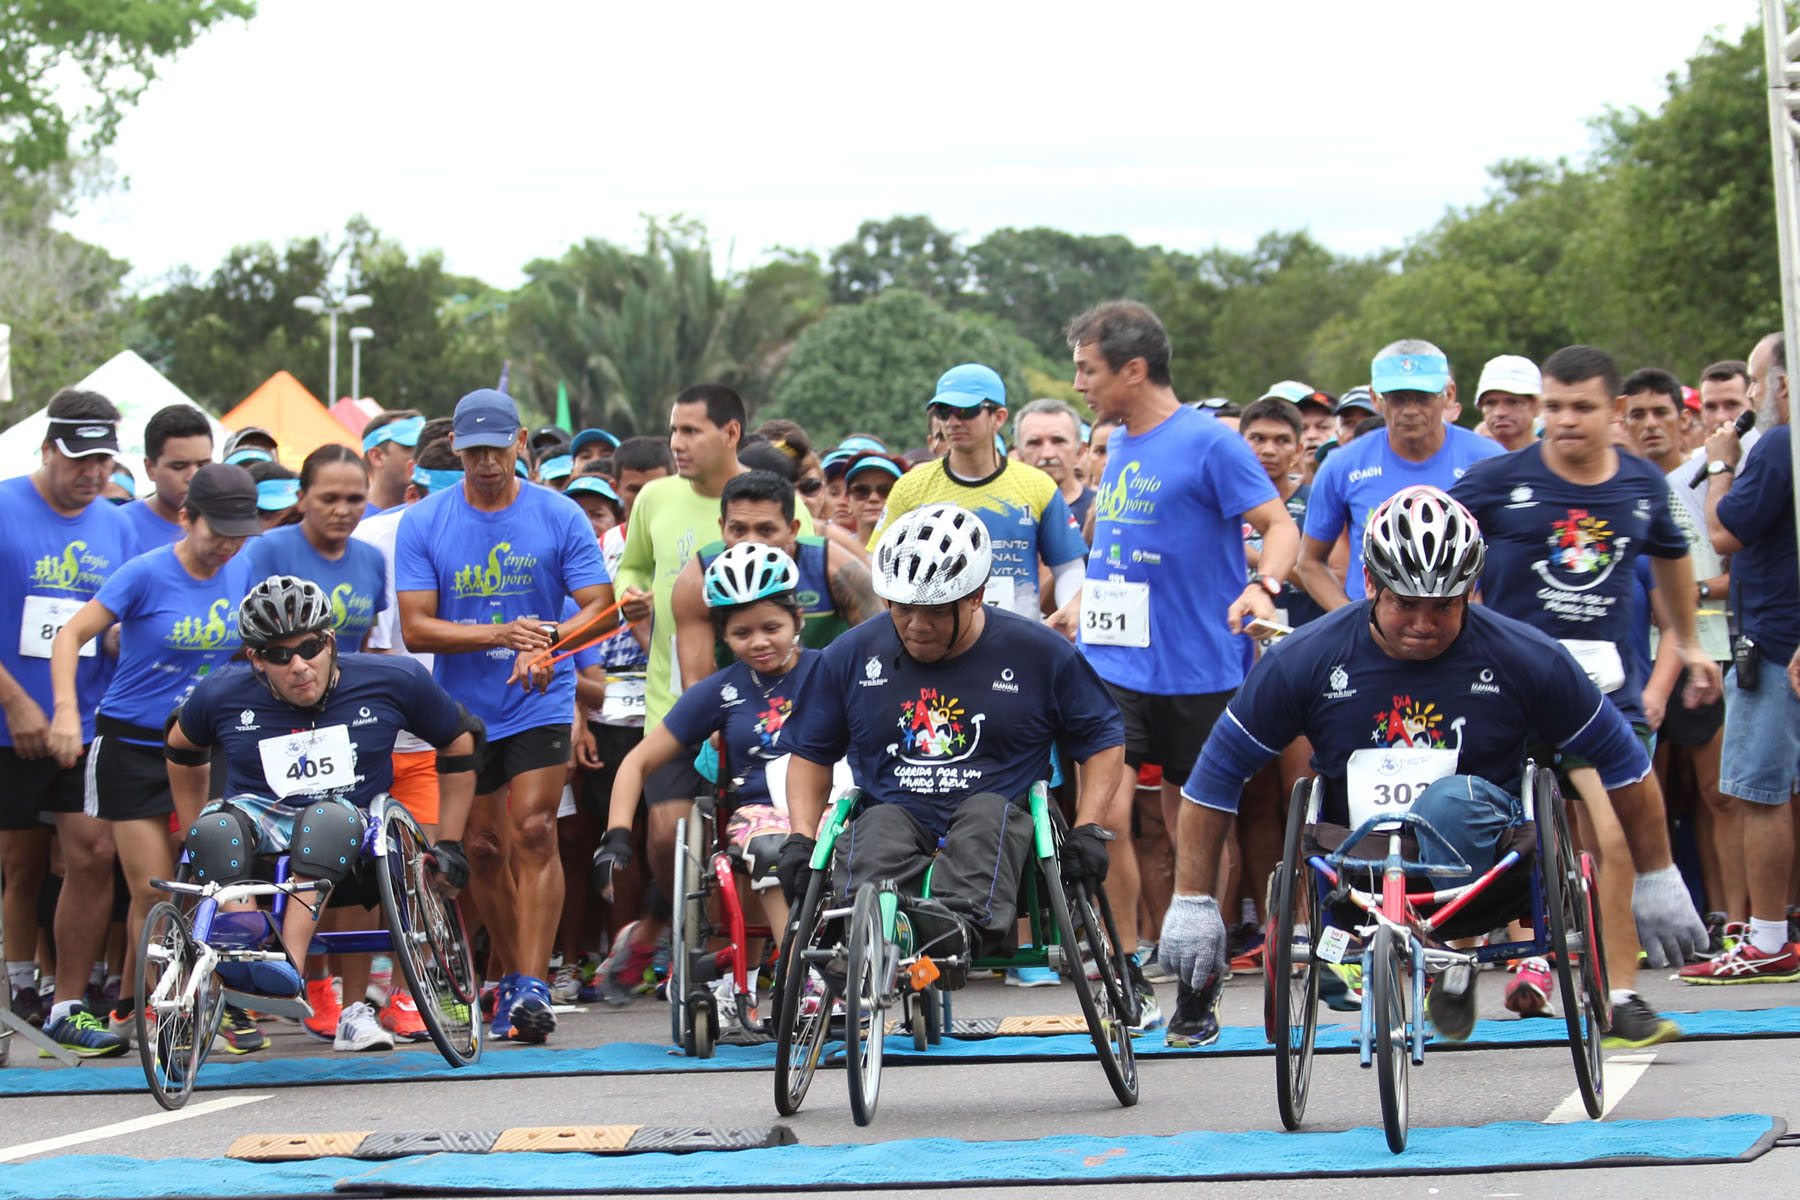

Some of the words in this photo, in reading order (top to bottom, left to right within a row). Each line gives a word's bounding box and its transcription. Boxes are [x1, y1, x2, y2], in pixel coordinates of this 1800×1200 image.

[1349, 466, 1383, 483] COACH
[486, 542, 537, 595] Sérgio
[1086, 610, 1127, 632] 351
[286, 756, 334, 780] 405
[894, 766, 932, 777] CORRIDA
[936, 767, 957, 777] POR
[963, 769, 982, 778] UM
[899, 777, 934, 788] MUNDO
[938, 778, 969, 789] AZUL
